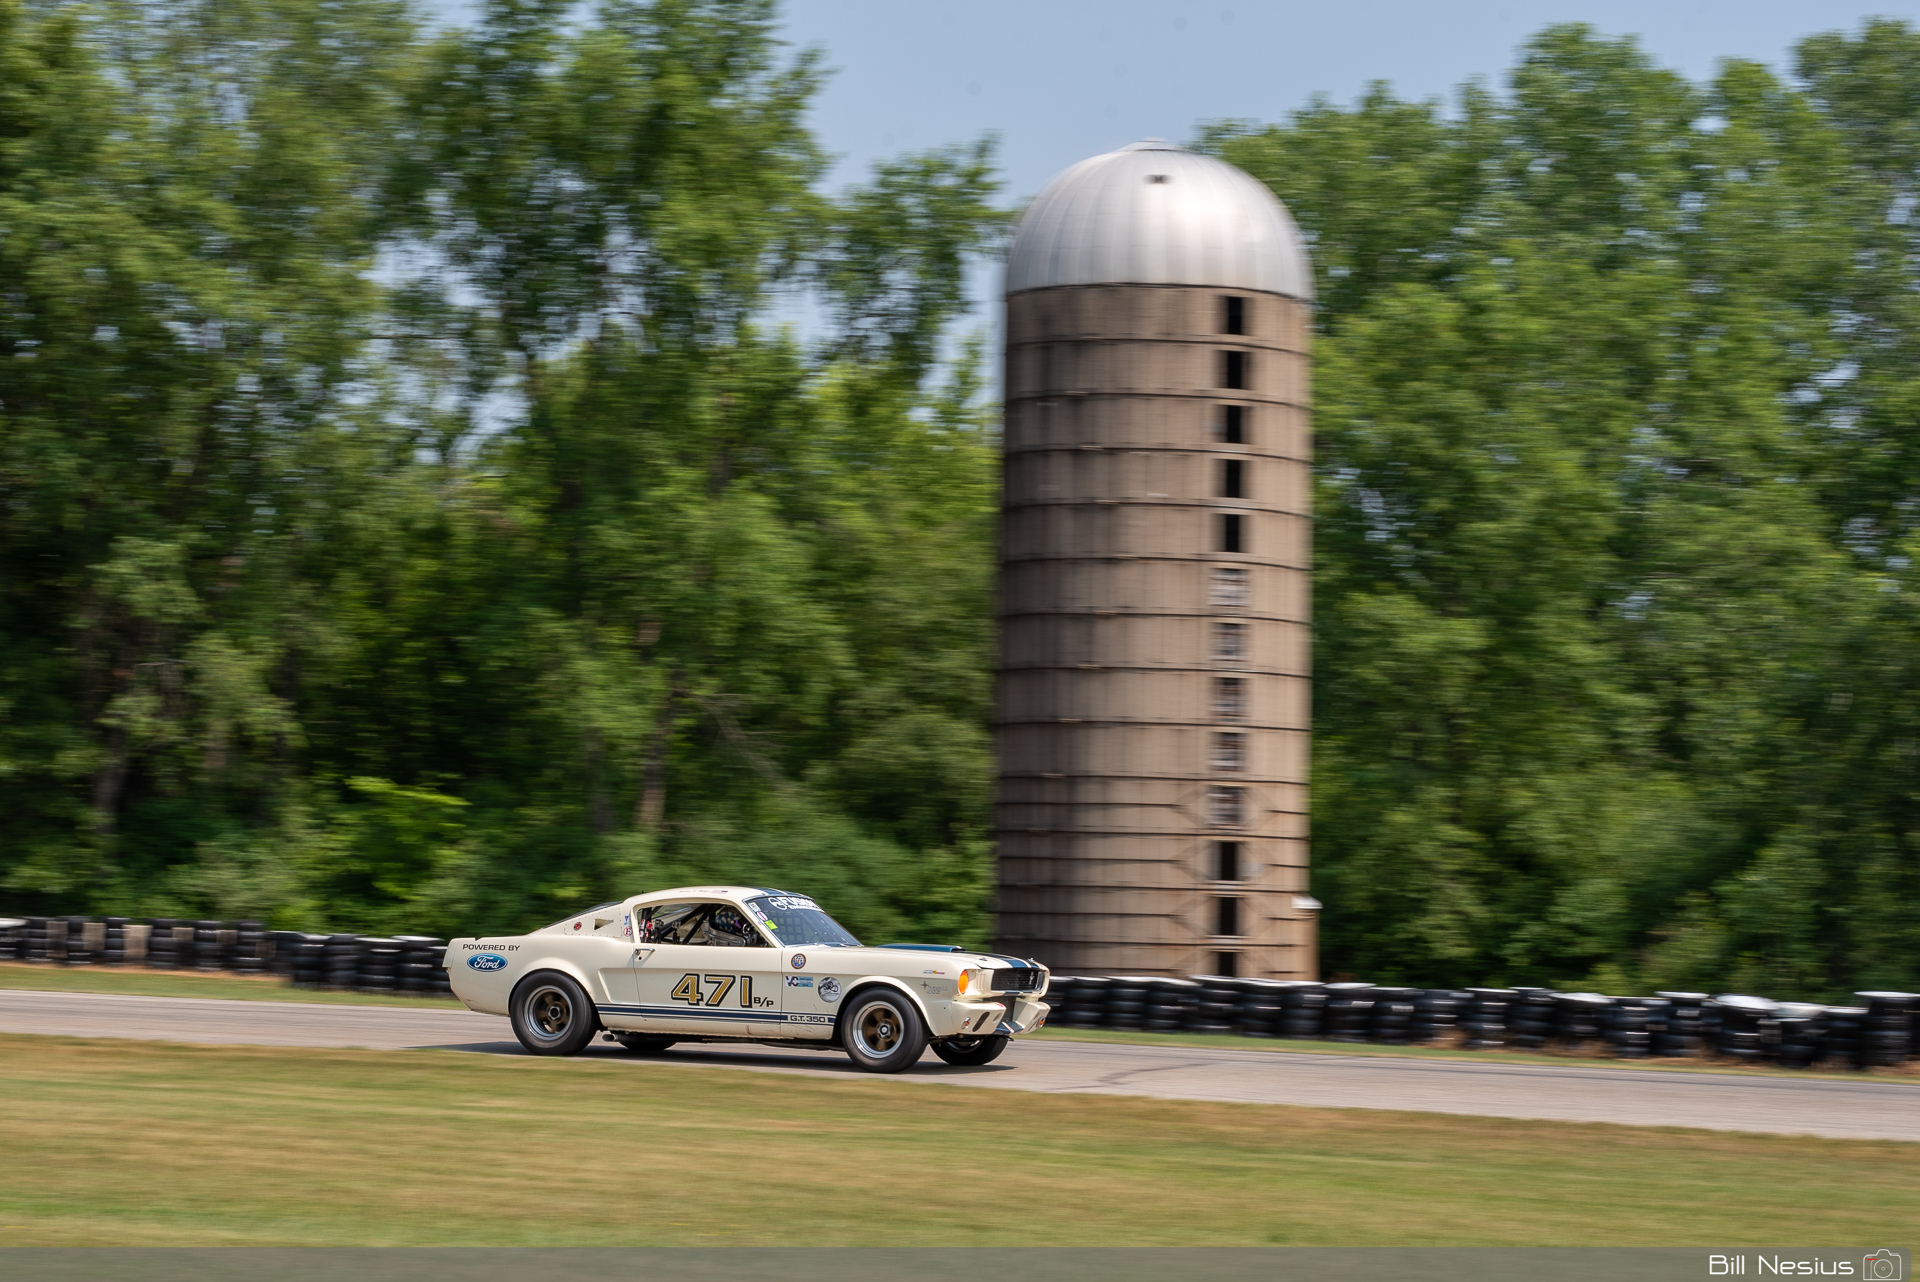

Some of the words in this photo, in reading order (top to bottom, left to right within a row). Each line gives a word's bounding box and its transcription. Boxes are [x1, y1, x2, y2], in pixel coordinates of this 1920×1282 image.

[474, 955, 501, 969] Ford
[671, 973, 753, 1009] 471
[753, 996, 774, 1007] B/P
